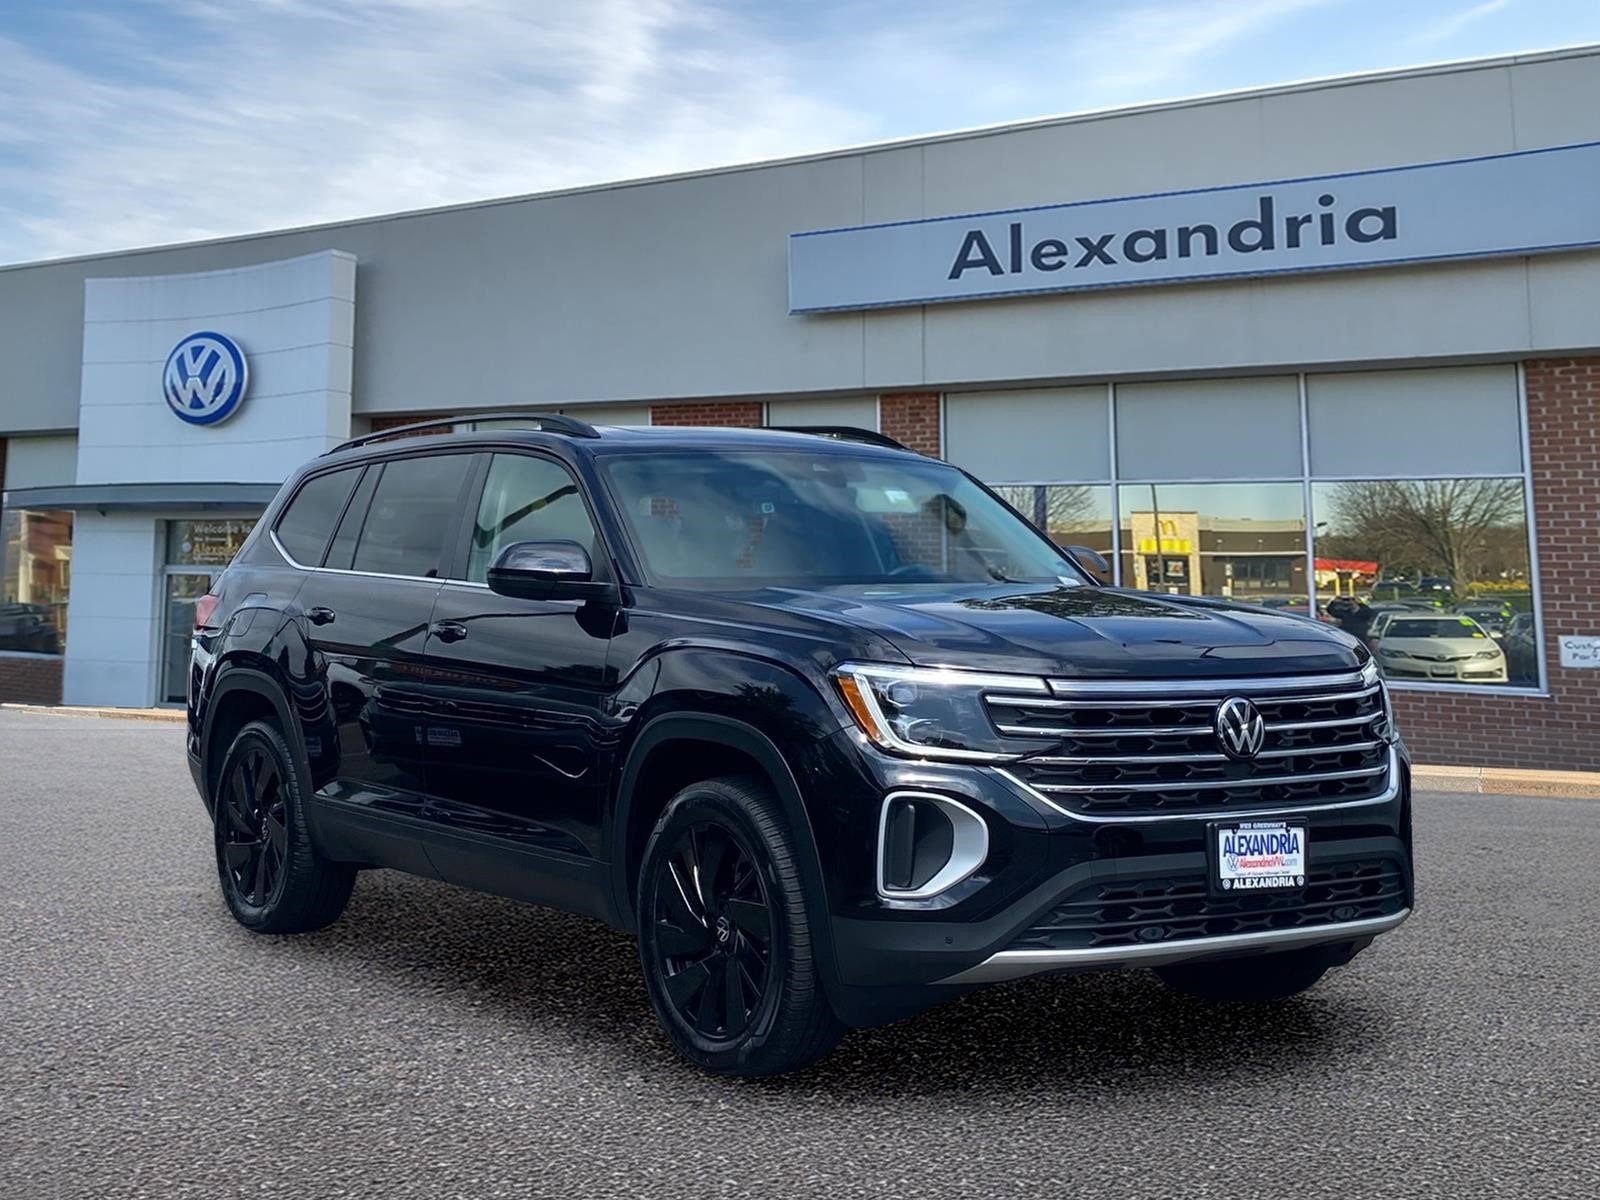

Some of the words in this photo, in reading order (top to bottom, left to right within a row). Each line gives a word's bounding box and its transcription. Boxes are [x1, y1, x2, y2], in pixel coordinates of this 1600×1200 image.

[947, 193, 1397, 280] Alexandria
[164, 336, 240, 419] VW
[1223, 832, 1300, 857] ALEXANDRIA
[1232, 876, 1295, 889] ALEXANDRIA
